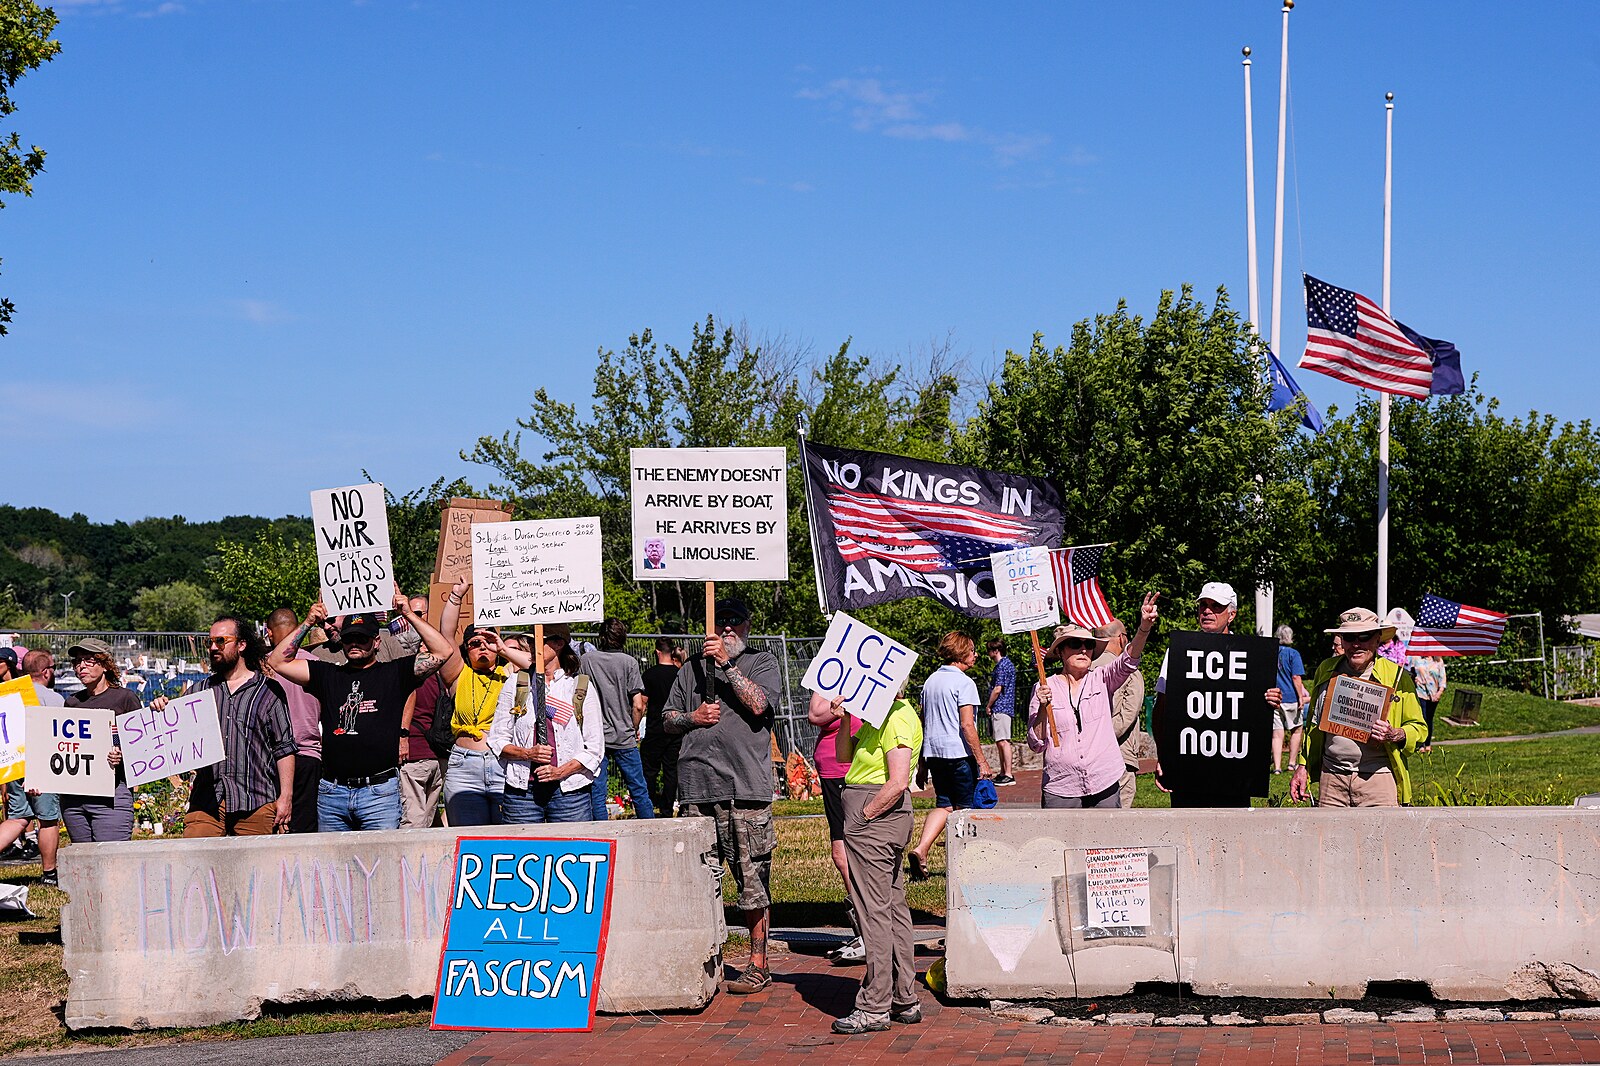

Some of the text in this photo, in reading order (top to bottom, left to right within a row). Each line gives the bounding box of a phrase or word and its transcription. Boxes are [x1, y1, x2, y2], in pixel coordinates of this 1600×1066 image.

[634, 465, 782, 482] THE ENEMY DOESN'T
[822, 458, 1033, 517] NO KINGS IN
[330, 489, 364, 521] NO
[644, 494, 774, 511] ARRIVE BY BOAT,
[452, 512, 474, 524] HEY
[320, 520, 375, 551] WAR
[450, 524, 472, 536] POL
[514, 528, 535, 541] Durán
[656, 520, 777, 535] HE ARRIVES BY
[339, 551, 362, 561] BUT
[514, 542, 539, 555] asylum
[541, 541, 566, 549] seeker
[672, 546, 759, 561] LIMOUSINE.
[1005, 548, 1033, 566] ICE
[324, 554, 386, 587] CLASS
[521, 566, 539, 575] work
[540, 563, 565, 576] permit
[1008, 565, 1037, 579] OUT
[545, 575, 570, 585] record
[844, 557, 999, 609] AMERIC
[1012, 580, 1041, 596] FOR
[332, 583, 383, 611] WAR
[556, 586, 586, 596] husband
[478, 608, 501, 620] ARE
[509, 604, 526, 617] WE
[529, 603, 555, 616] SAFE
[836, 623, 907, 682] ICE
[1185, 649, 1248, 681] ICE
[816, 657, 887, 712] OUT
[1340, 679, 1360, 691] IMPEACH
[1186, 690, 1245, 720] OUT
[1337, 694, 1379, 715] CONSTITUTION
[1339, 706, 1366, 721] DEMANDS
[52, 718, 92, 739] ICE
[123, 699, 203, 745] SHUT
[1328, 722, 1341, 734] NO
[57, 741, 80, 753] CTF
[151, 729, 179, 750] IT
[1180, 726, 1250, 759] NOW
[49, 752, 95, 776] OUT
[131, 738, 204, 777] DOWN
[454, 852, 608, 915] RESIST
[138, 852, 453, 957] HOW MANY MO
[1095, 896, 1146, 909] Killed by
[1101, 910, 1130, 924] ICE
[483, 917, 560, 941] ALL
[444, 958, 588, 999] FASCISM
